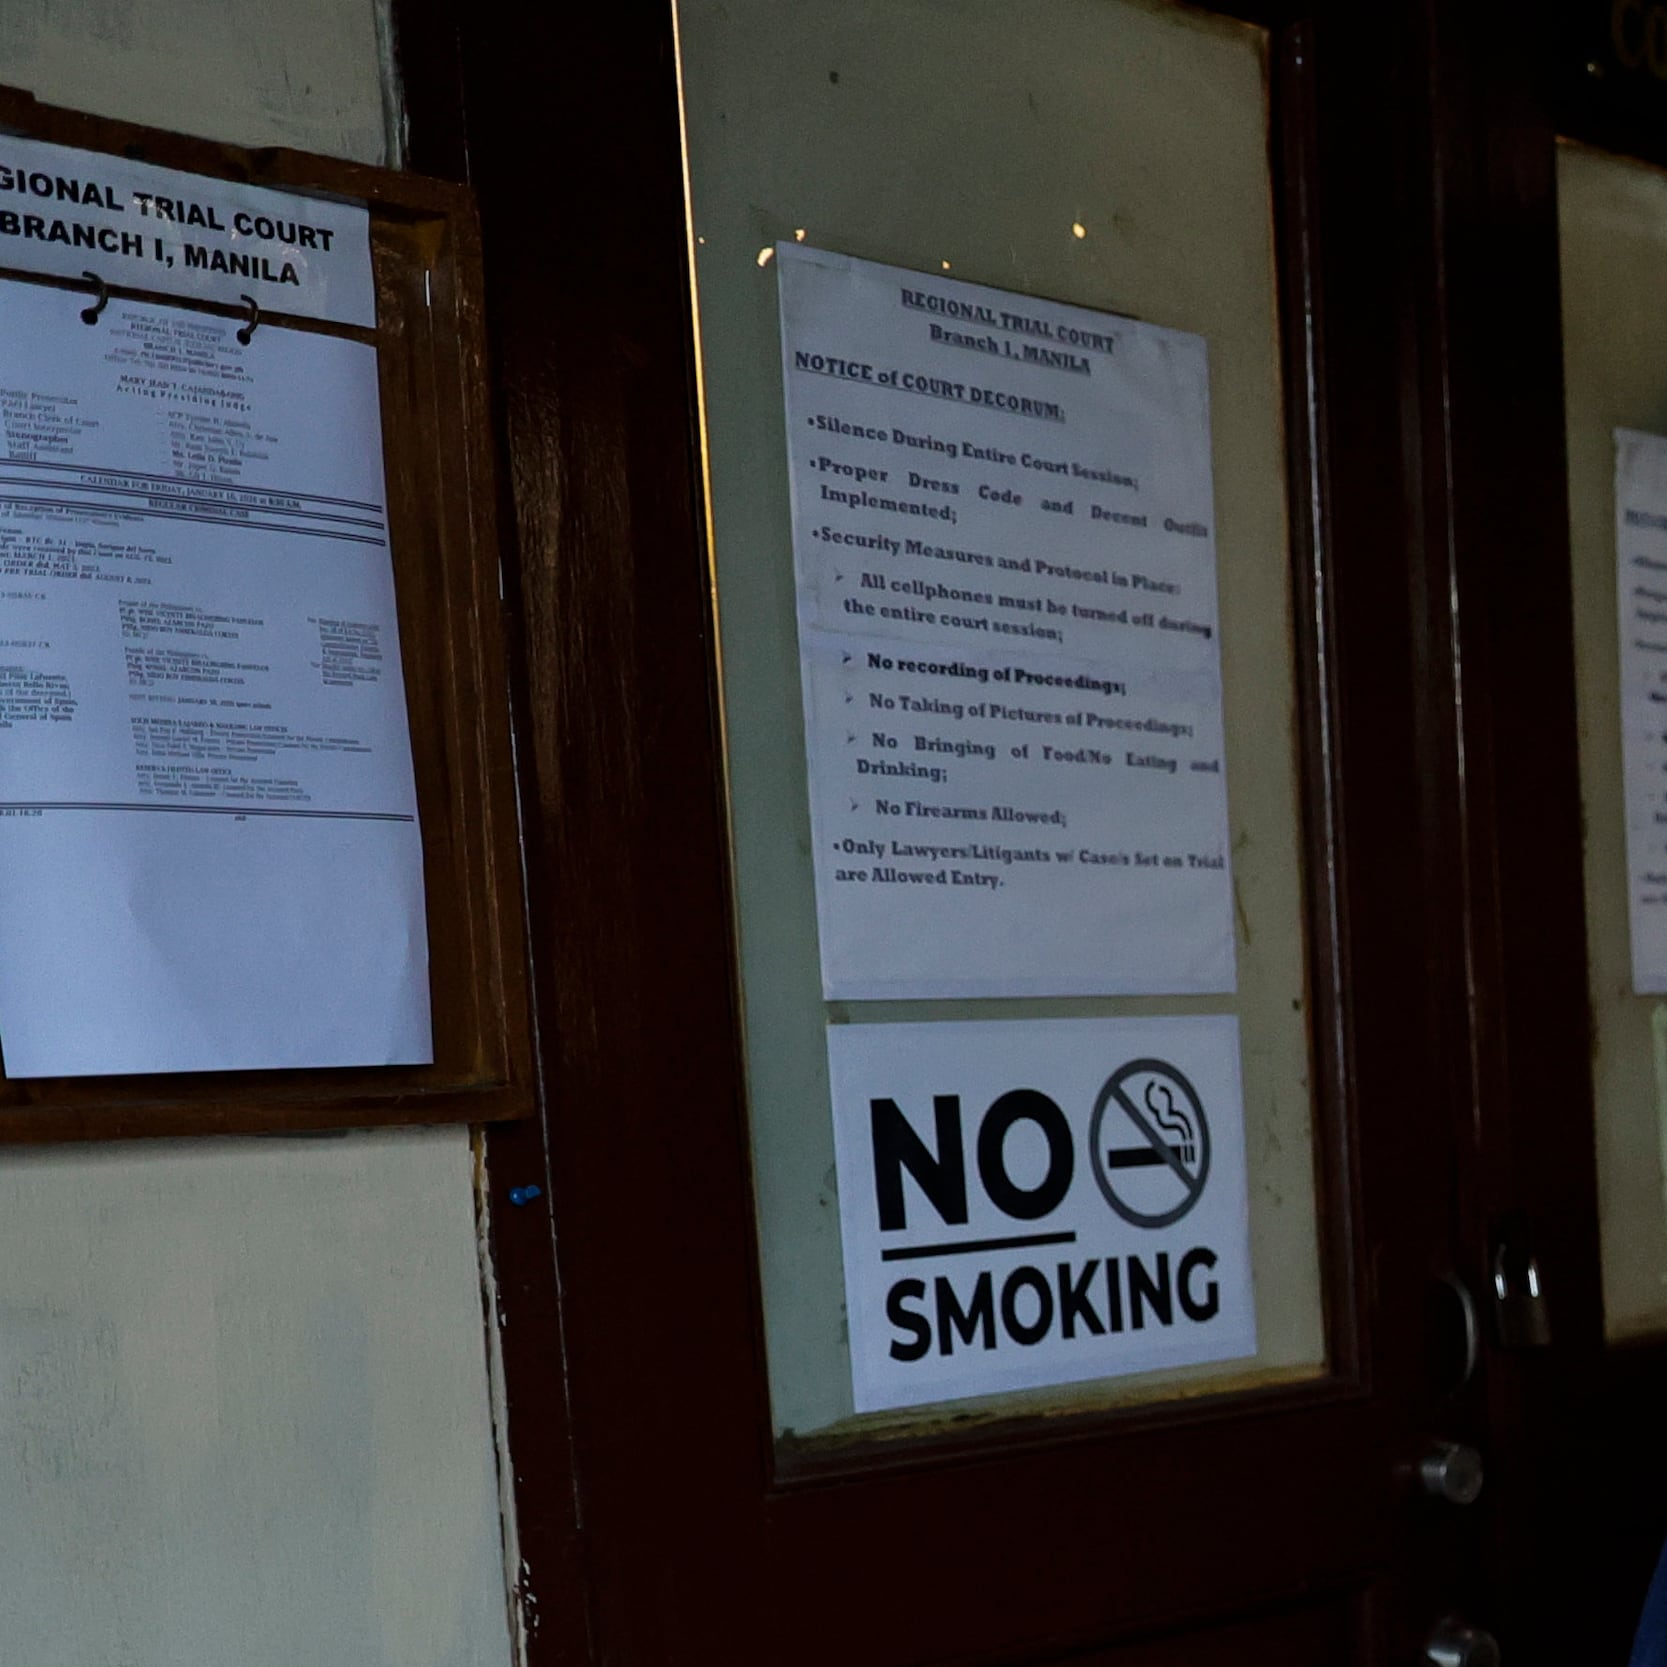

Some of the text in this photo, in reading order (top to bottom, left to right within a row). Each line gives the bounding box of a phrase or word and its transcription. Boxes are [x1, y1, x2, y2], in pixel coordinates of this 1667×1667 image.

[0, 211, 143, 257] BRANCH
[185, 244, 299, 286] MANILA
[133, 192, 225, 231] TRIAL
[234, 212, 334, 251] COURT
[901, 288, 1114, 353] REGIONAL TRIAL COURT
[929, 323, 998, 353] Branch
[1023, 344, 1091, 375] MANILA
[795, 350, 1065, 422] NOTICE of COURT DECORUM:
[817, 414, 888, 441] Silence
[893, 429, 957, 458] During
[962, 442, 1016, 466] Entire
[1021, 453, 1068, 475] Court
[819, 456, 888, 482] Proper
[909, 471, 960, 494] Dress
[978, 484, 1022, 506] Code
[1041, 499, 1073, 515] and
[1091, 504, 1147, 528] Decent
[820, 484, 957, 525] Implemented;
[821, 526, 900, 556] Security
[905, 538, 993, 567] Measures
[998, 557, 1031, 573] and
[1036, 560, 1109, 584] Protocol
[1112, 571, 1128, 587] in
[844, 598, 1063, 643] the entire court session;
[860, 572, 886, 590] All
[890, 579, 993, 605] cellphones
[998, 594, 1042, 611] must
[1047, 598, 1067, 616] be
[1072, 604, 1128, 624] turned
[1132, 613, 1154, 628] off
[867, 652, 1126, 697] No recording of Proceedings;
[869, 692, 1193, 738] No Taking of Pictures of Proceedings;
[856, 758, 948, 783] Drinking;
[872, 732, 898, 749] No
[914, 734, 995, 760] Bringing
[1011, 743, 1028, 759] of
[1190, 760, 1219, 773] and
[876, 799, 1066, 828] No Firearms Allowed;
[835, 867, 1004, 890] are Allowed Entry.
[842, 838, 885, 859] Only
[1187, 853, 1224, 869] Trial
[870, 1088, 1075, 1231] NO
[885, 1247, 1220, 1362] SMOKING
